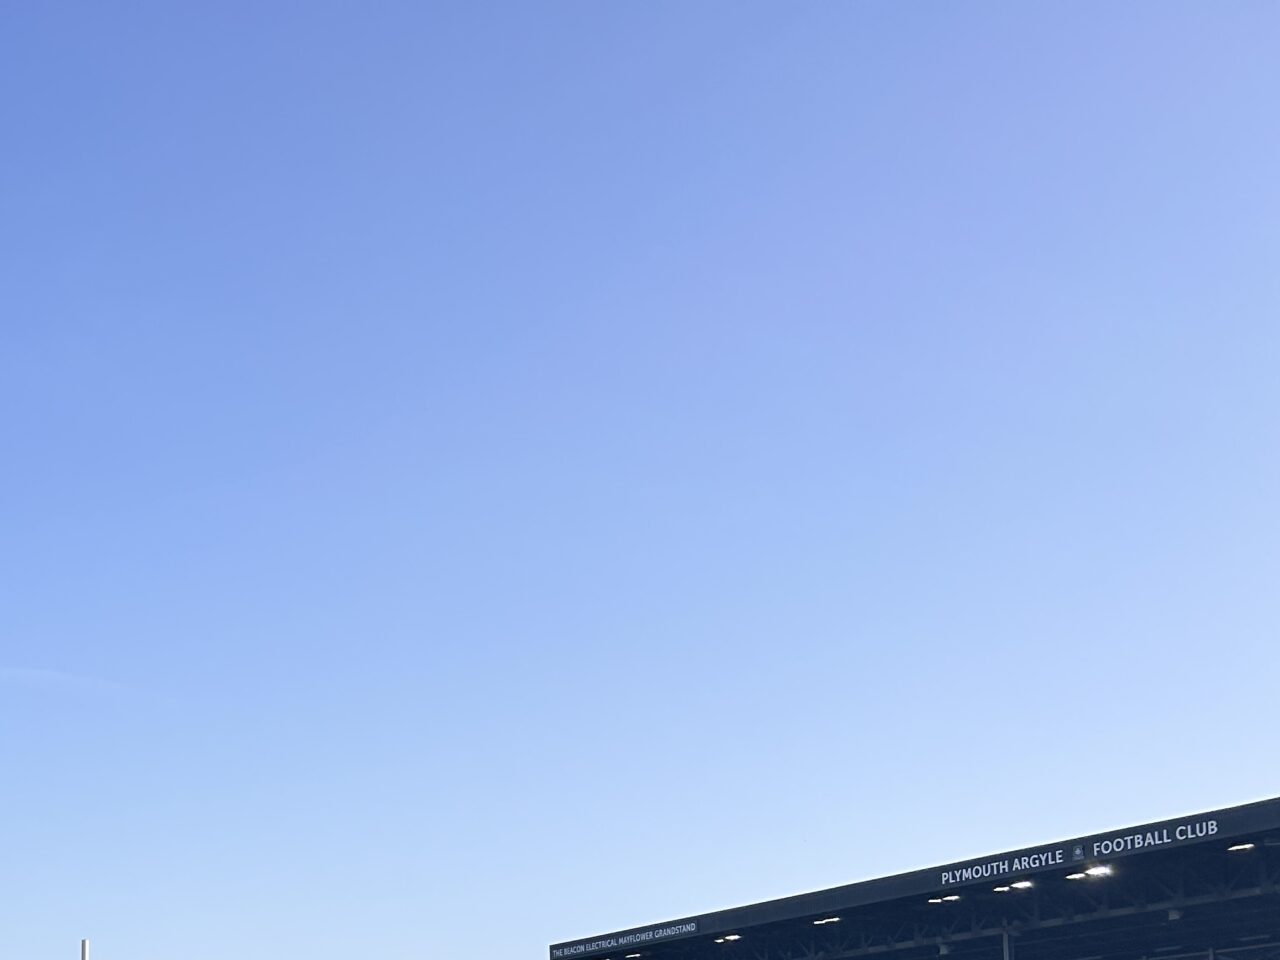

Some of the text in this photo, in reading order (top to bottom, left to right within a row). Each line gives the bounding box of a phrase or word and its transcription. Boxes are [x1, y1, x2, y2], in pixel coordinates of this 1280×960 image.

[1093, 820, 1218, 856] FOOTBALL CLUB
[941, 850, 1064, 885] PLYMOUTH ARGYLE
[553, 923, 696, 957] THE BEACON ELECTRICAL MAYFLOWER GRANDSTAND
